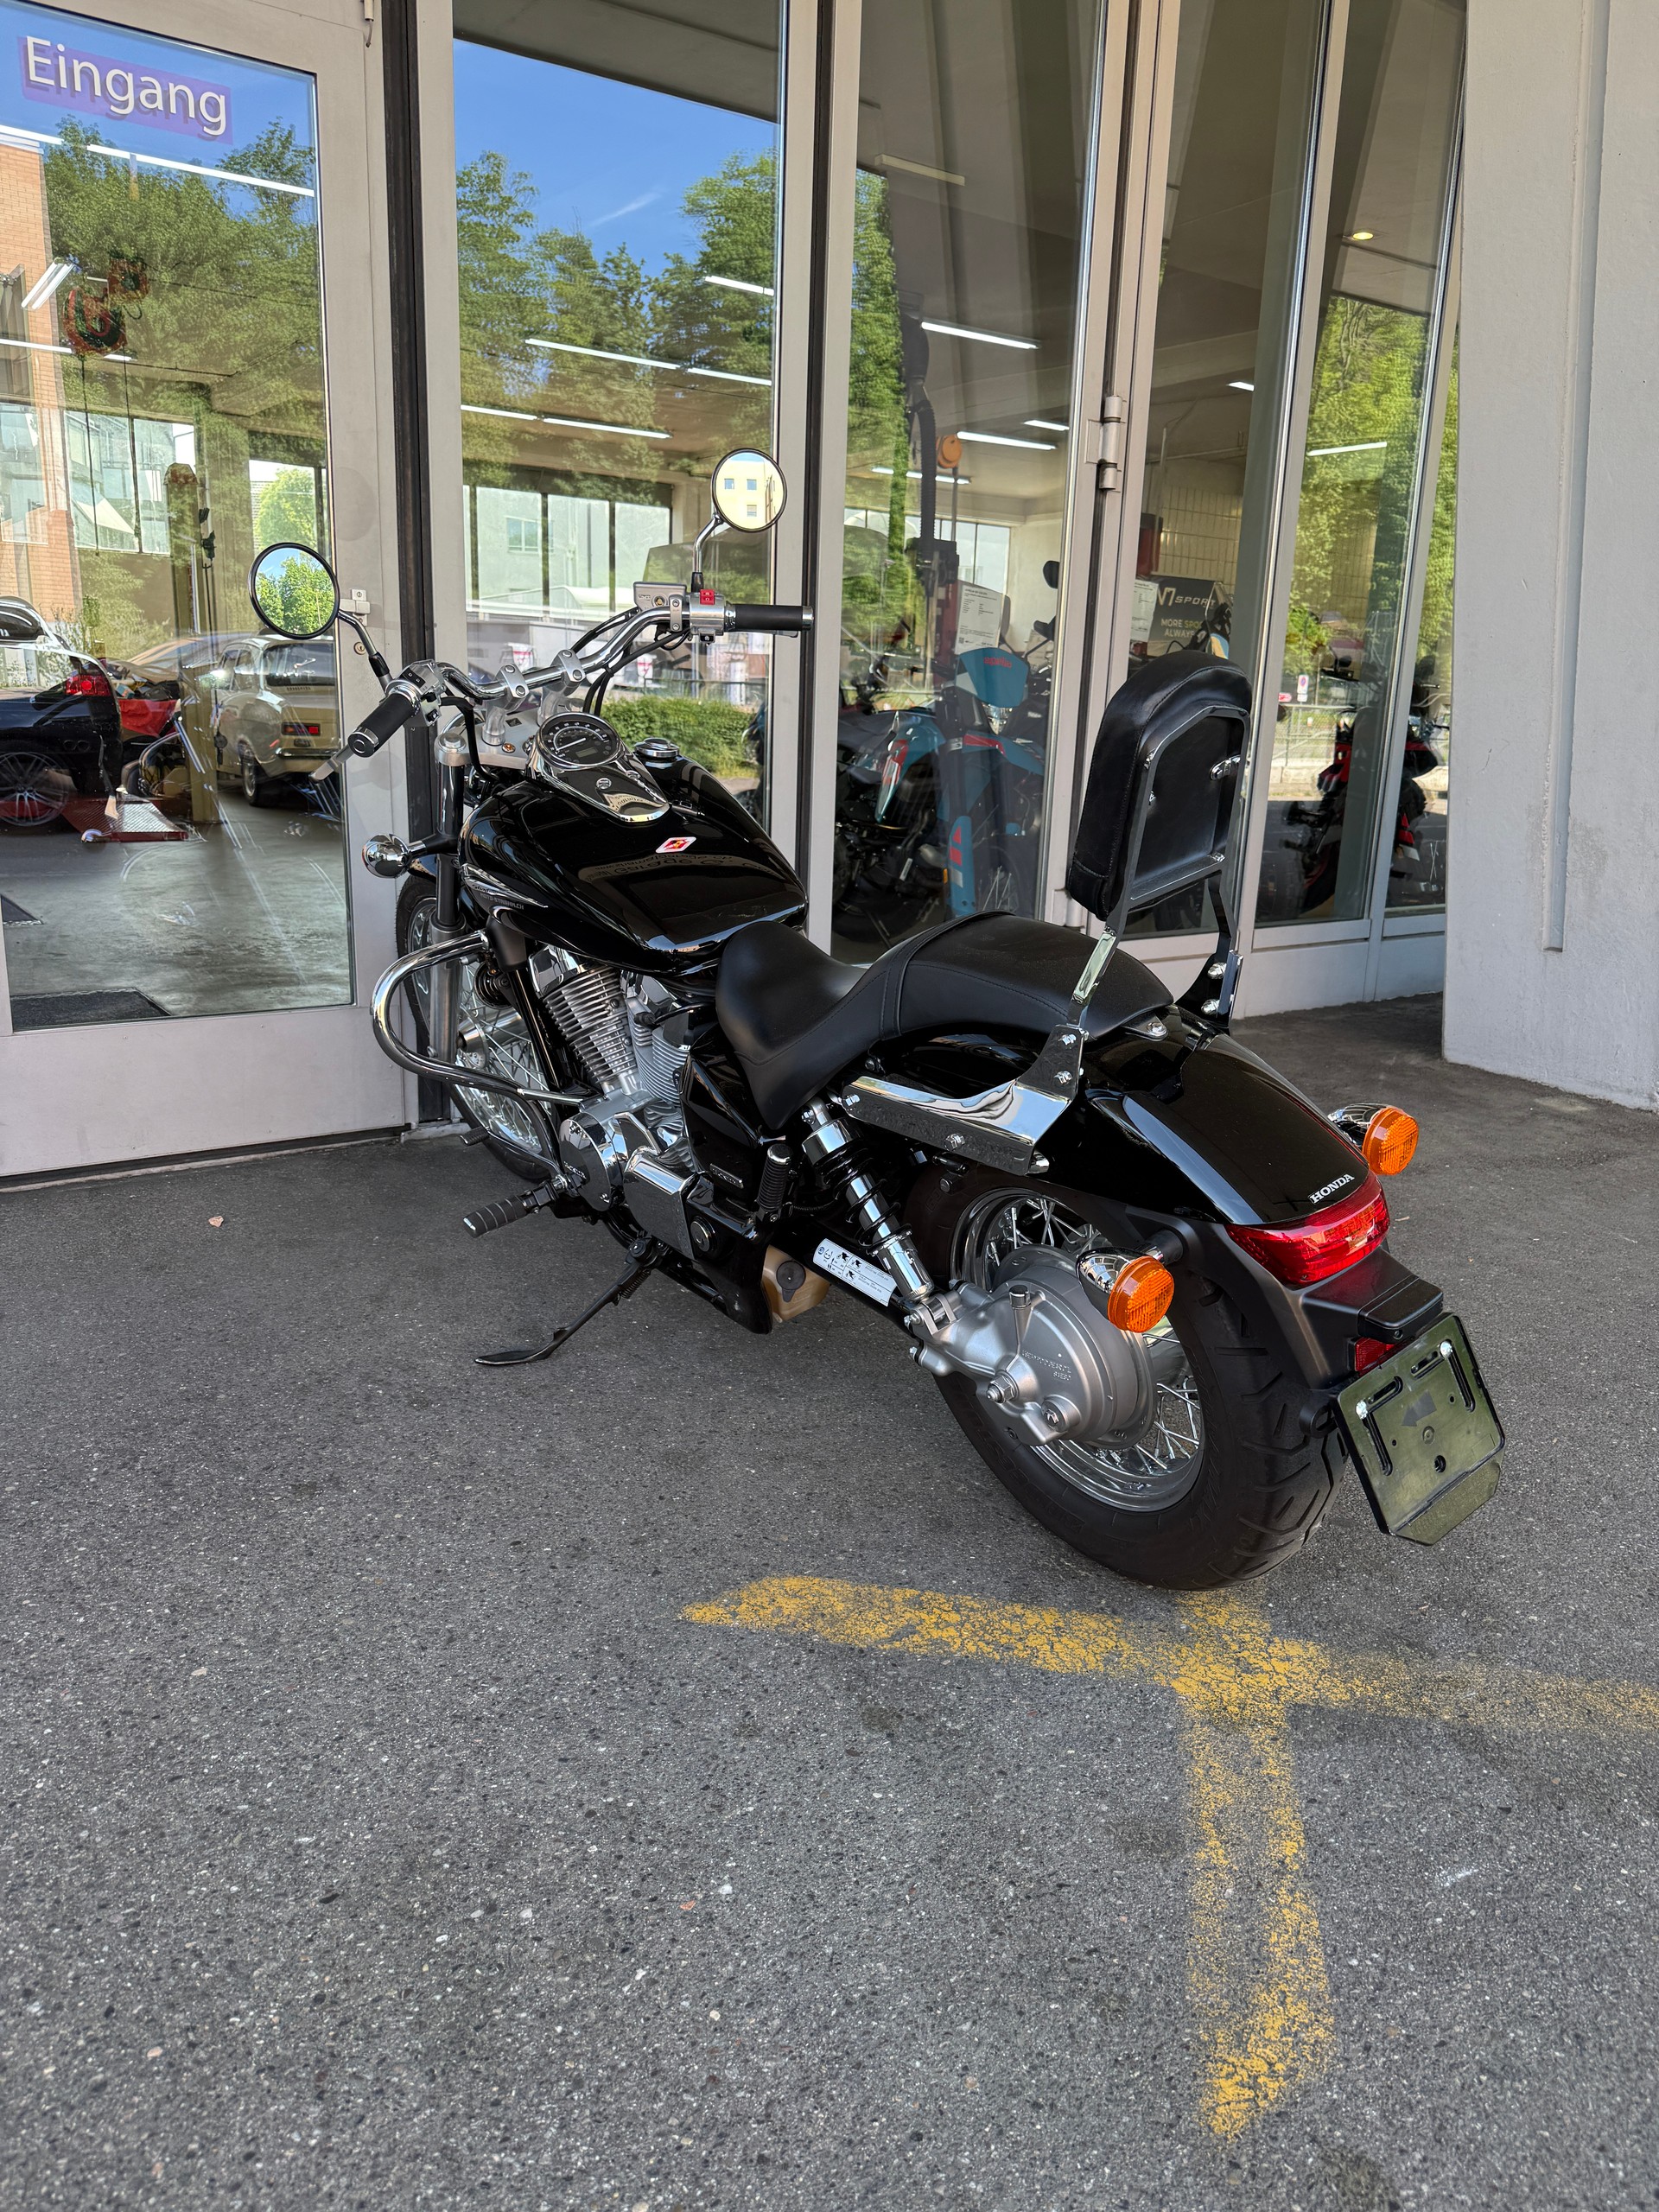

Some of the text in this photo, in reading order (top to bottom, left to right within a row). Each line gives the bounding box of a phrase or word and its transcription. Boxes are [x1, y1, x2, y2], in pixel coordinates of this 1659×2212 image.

[27, 35, 226, 136] Eingang
[1175, 595, 1216, 607] SPORT
[1160, 619, 1184, 629] MORE
[1309, 1173, 1355, 1204] HONDA
